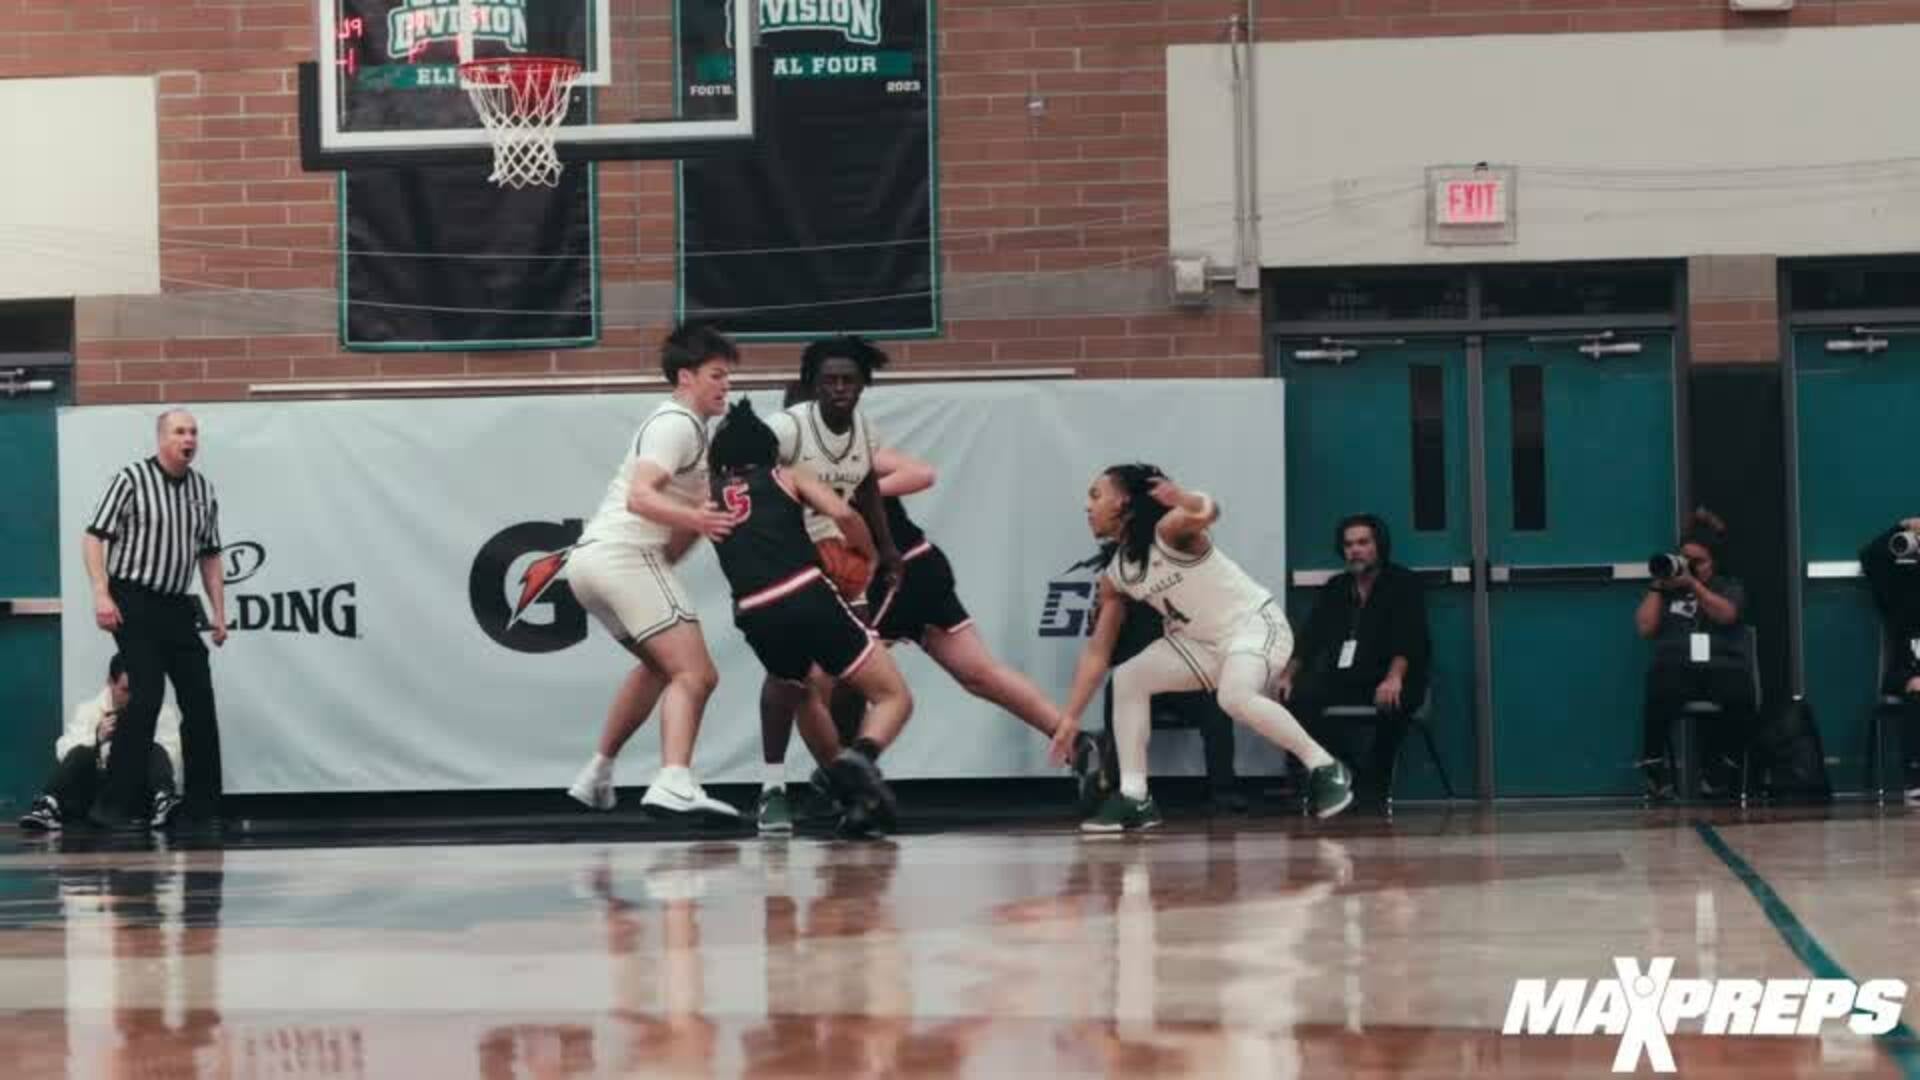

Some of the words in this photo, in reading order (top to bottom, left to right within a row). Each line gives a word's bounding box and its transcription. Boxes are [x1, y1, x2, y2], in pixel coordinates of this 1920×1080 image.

[759, 0, 875, 37] VISION
[416, 67, 456, 85] ELI
[773, 57, 803, 74] AL
[812, 56, 877, 73] FOUR
[1447, 182, 1498, 222] EXIT
[723, 480, 751, 525] 5
